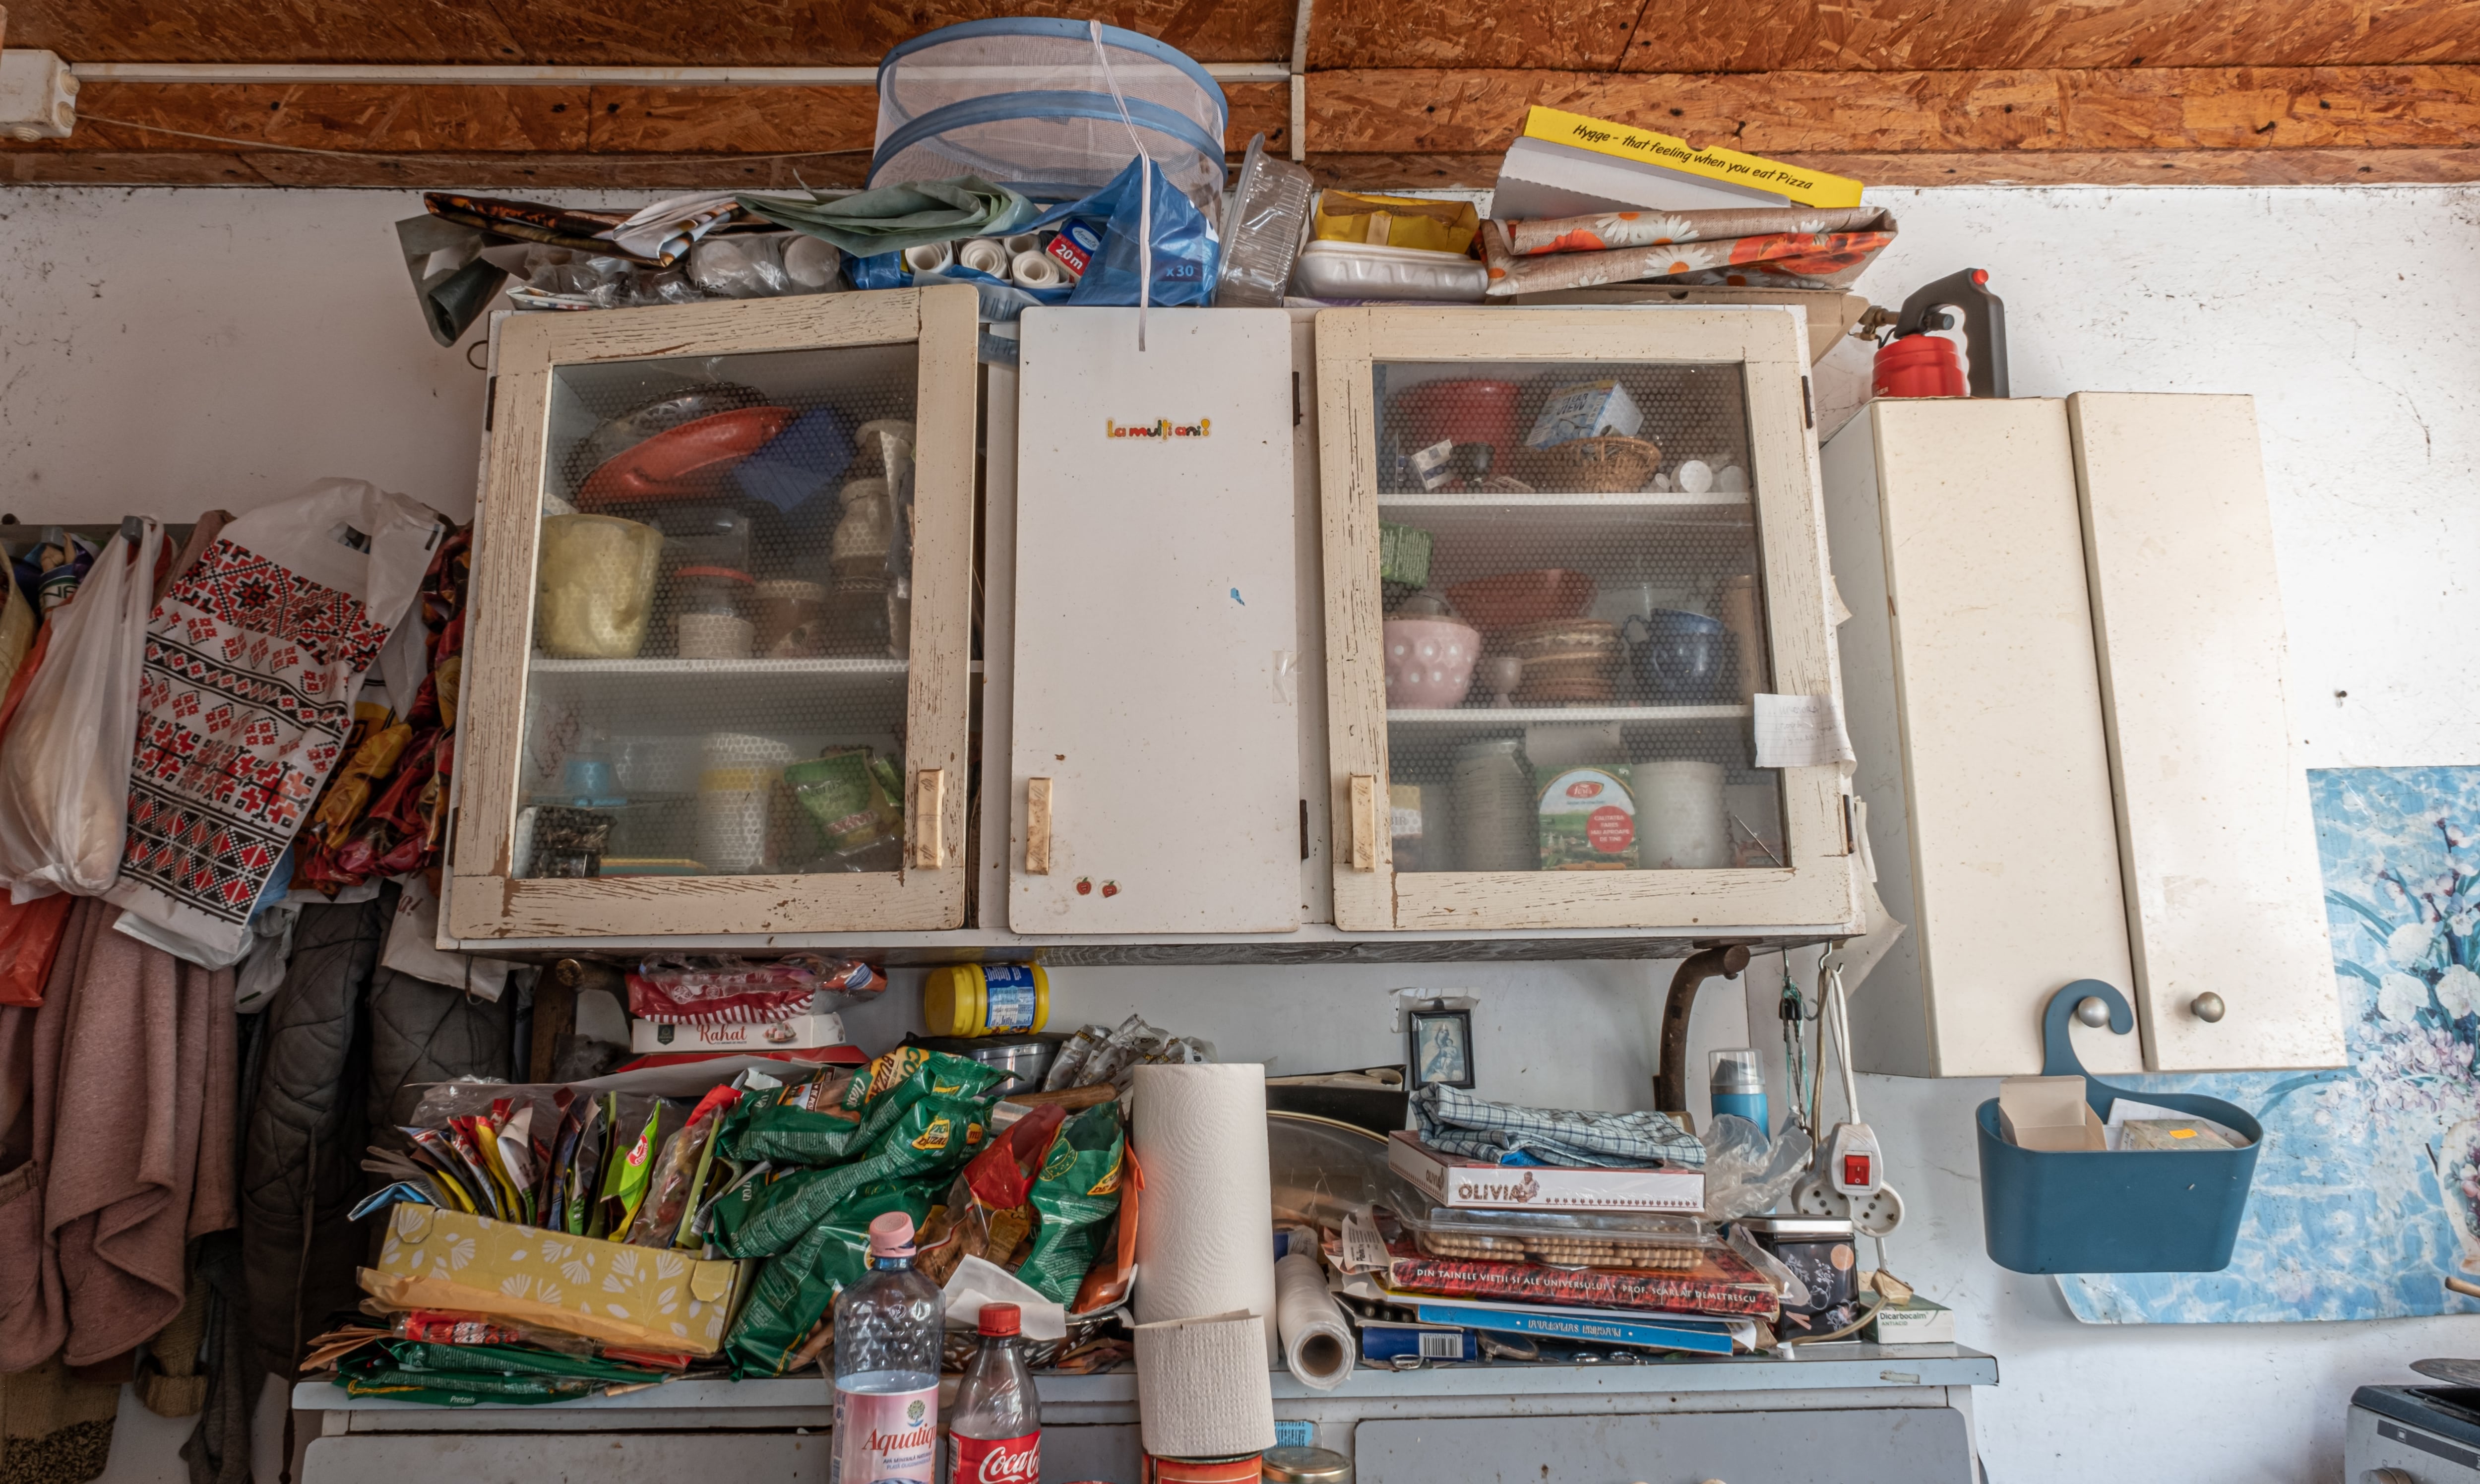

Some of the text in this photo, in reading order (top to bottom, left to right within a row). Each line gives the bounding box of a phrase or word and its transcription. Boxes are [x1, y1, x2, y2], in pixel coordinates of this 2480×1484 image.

[1573, 124, 1611, 143] Hygge
[1622, 135, 1651, 150] that
[1650, 142, 1692, 163] feeling
[1694, 154, 1726, 168] when
[1726, 162, 1751, 173] you
[1752, 170, 1777, 180] eat
[1776, 172, 1813, 189] Pizza
[1108, 420, 1126, 437] La
[697, 1024, 747, 1045] Rahat
[1439, 1270, 1477, 1281] TAINELE
[1543, 1279, 1606, 1290] UNIVERSULUI
[1622, 1285, 1648, 1294] PROF.
[1652, 1288, 1691, 1298] SCARLAT
[1695, 1291, 1756, 1303] DEMETRESCU
[450, 1395, 476, 1404] Pretzels
